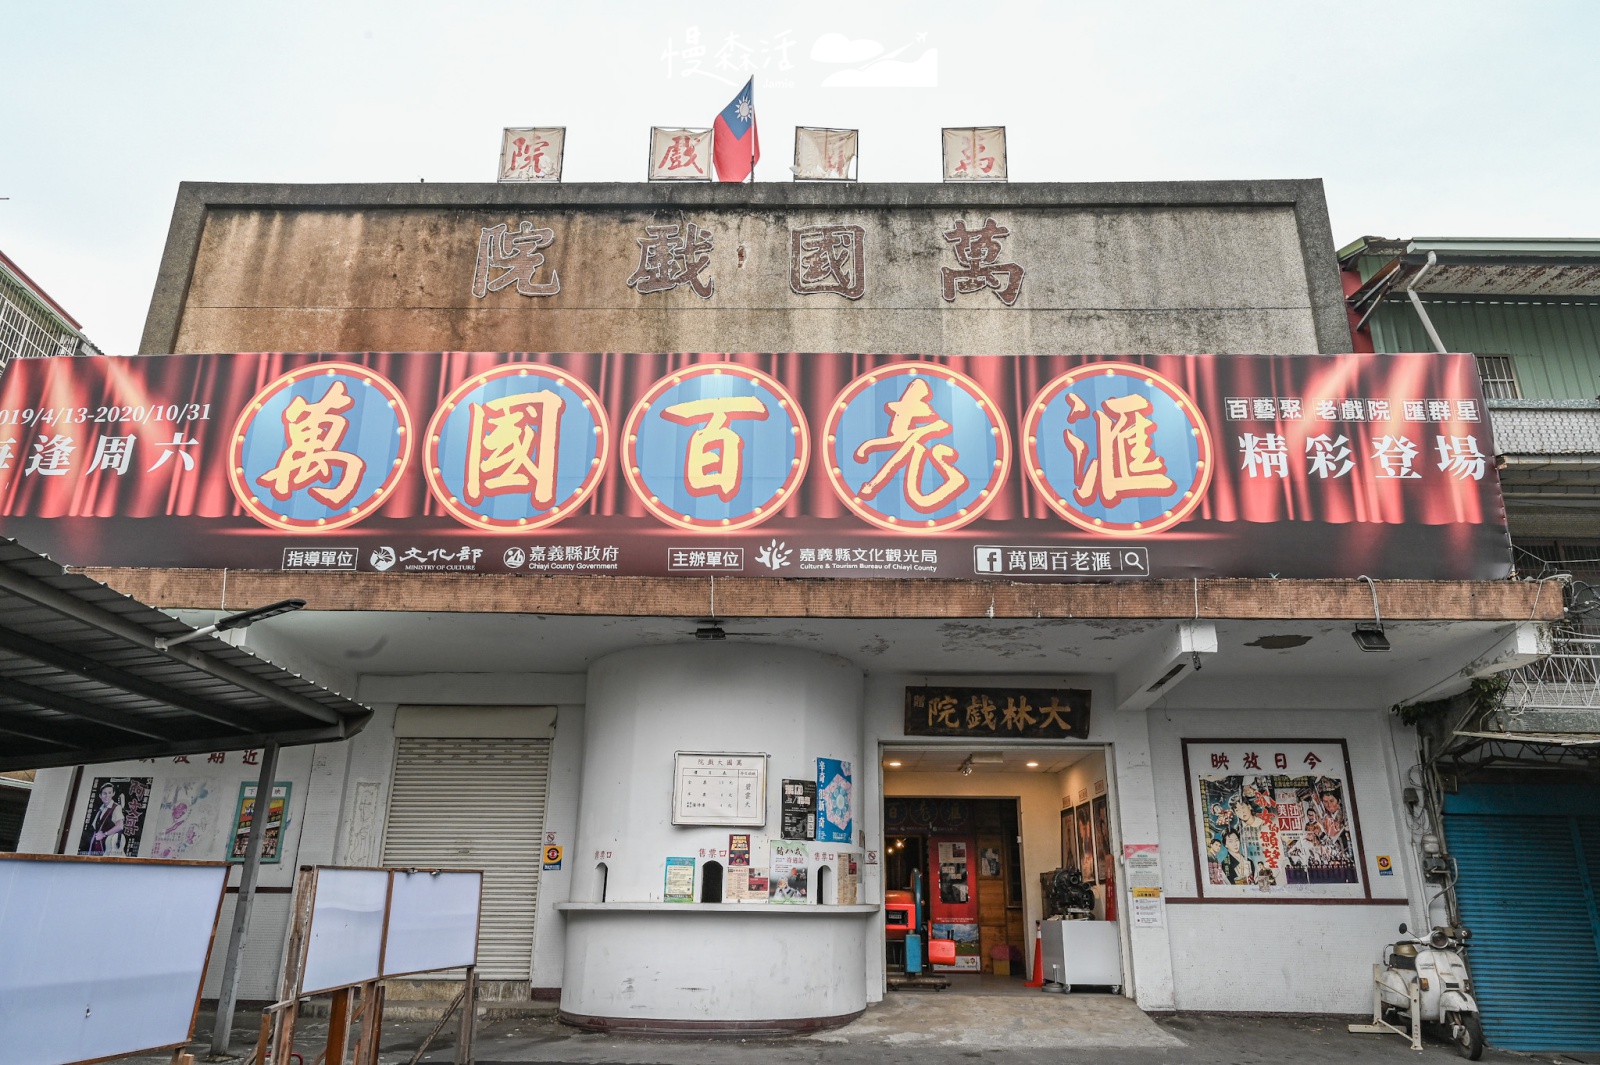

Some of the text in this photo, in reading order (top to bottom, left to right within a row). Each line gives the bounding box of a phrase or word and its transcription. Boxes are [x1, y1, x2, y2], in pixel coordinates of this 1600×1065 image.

[1226, 398, 1304, 421] 百藝聚
[1315, 398, 1392, 421] 老戲院
[1239, 432, 1486, 481] 精彩登場
[287, 551, 353, 567] 指導單位
[400, 546, 484, 563] 文化部
[529, 545, 619, 562] 嘉義縣政府
[672, 551, 739, 567] 主辦單位
[799, 547, 938, 564] 嘉義縣文化觀光局
[528, 562, 618, 571] Chiayi County Government
[859, 563, 883, 571] Bureau
[884, 563, 891, 571] of
[892, 563, 913, 572] Chiayi
[914, 564, 938, 573] County
[1210, 751, 1322, 770] 今日放映
[698, 847, 727, 859] 售票口
[814, 851, 834, 862] 售票口
